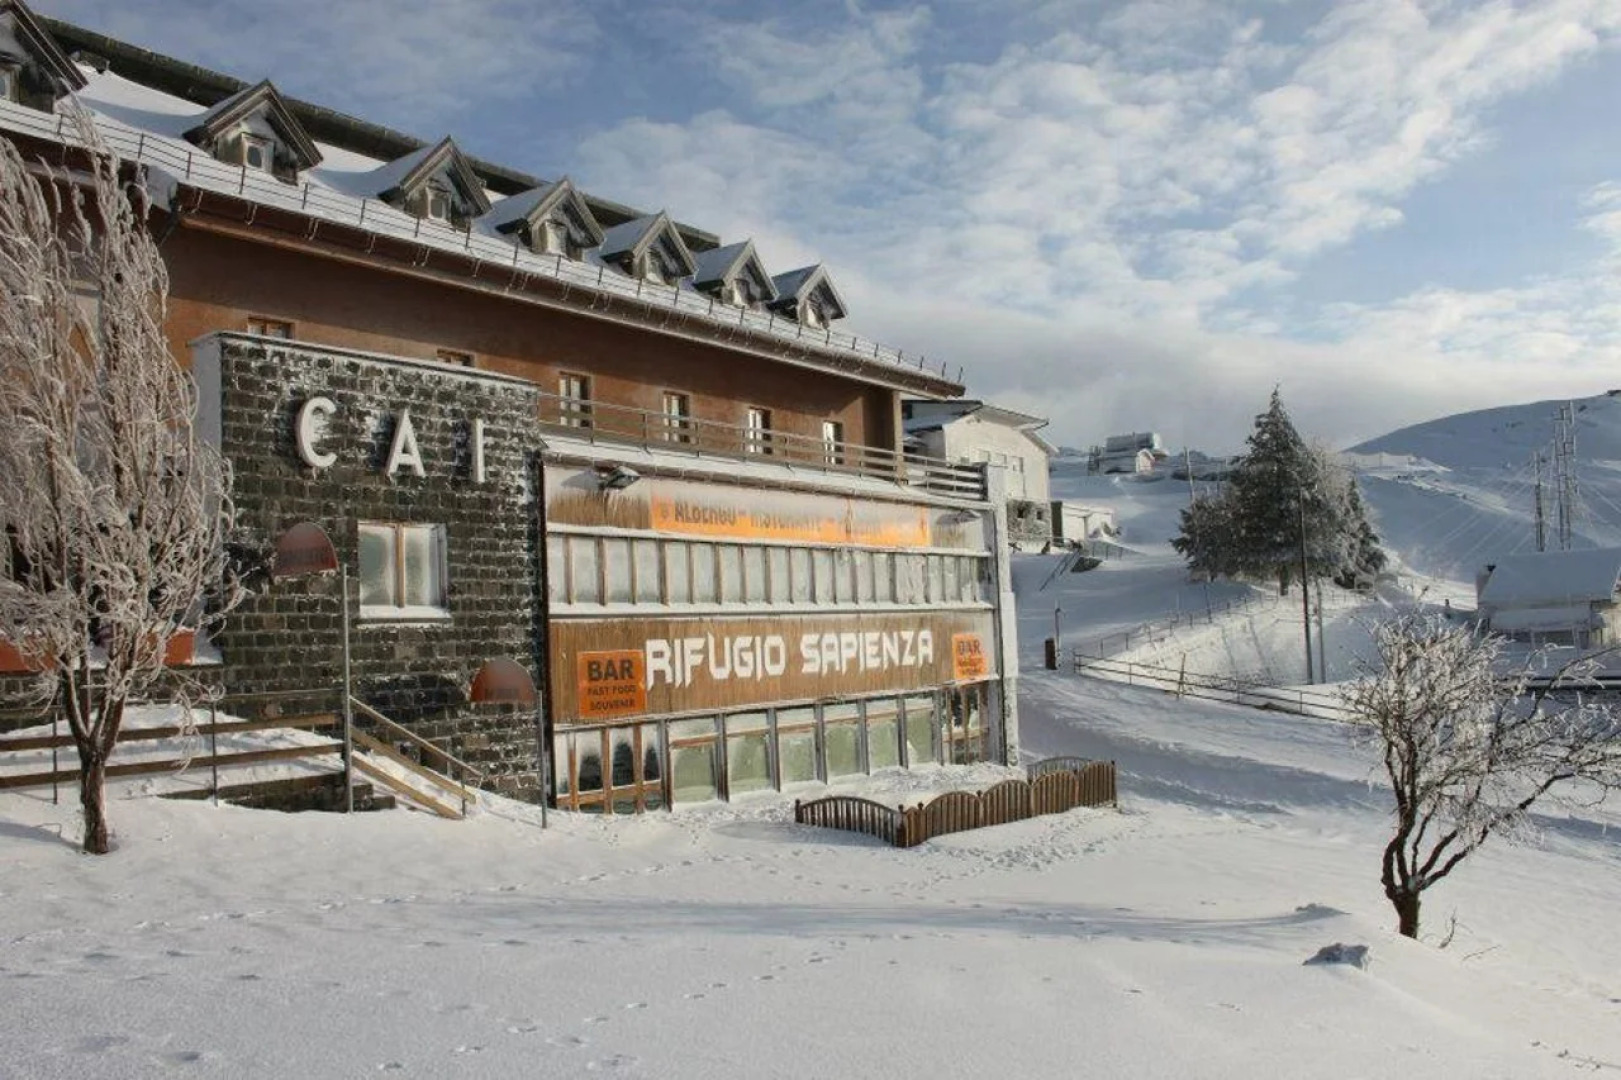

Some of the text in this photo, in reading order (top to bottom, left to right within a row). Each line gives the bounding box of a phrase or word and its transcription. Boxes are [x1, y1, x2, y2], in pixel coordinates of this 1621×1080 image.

[587, 659, 634, 681] BAR
[645, 629, 934, 692] RIFUGIO SAPIENZA
